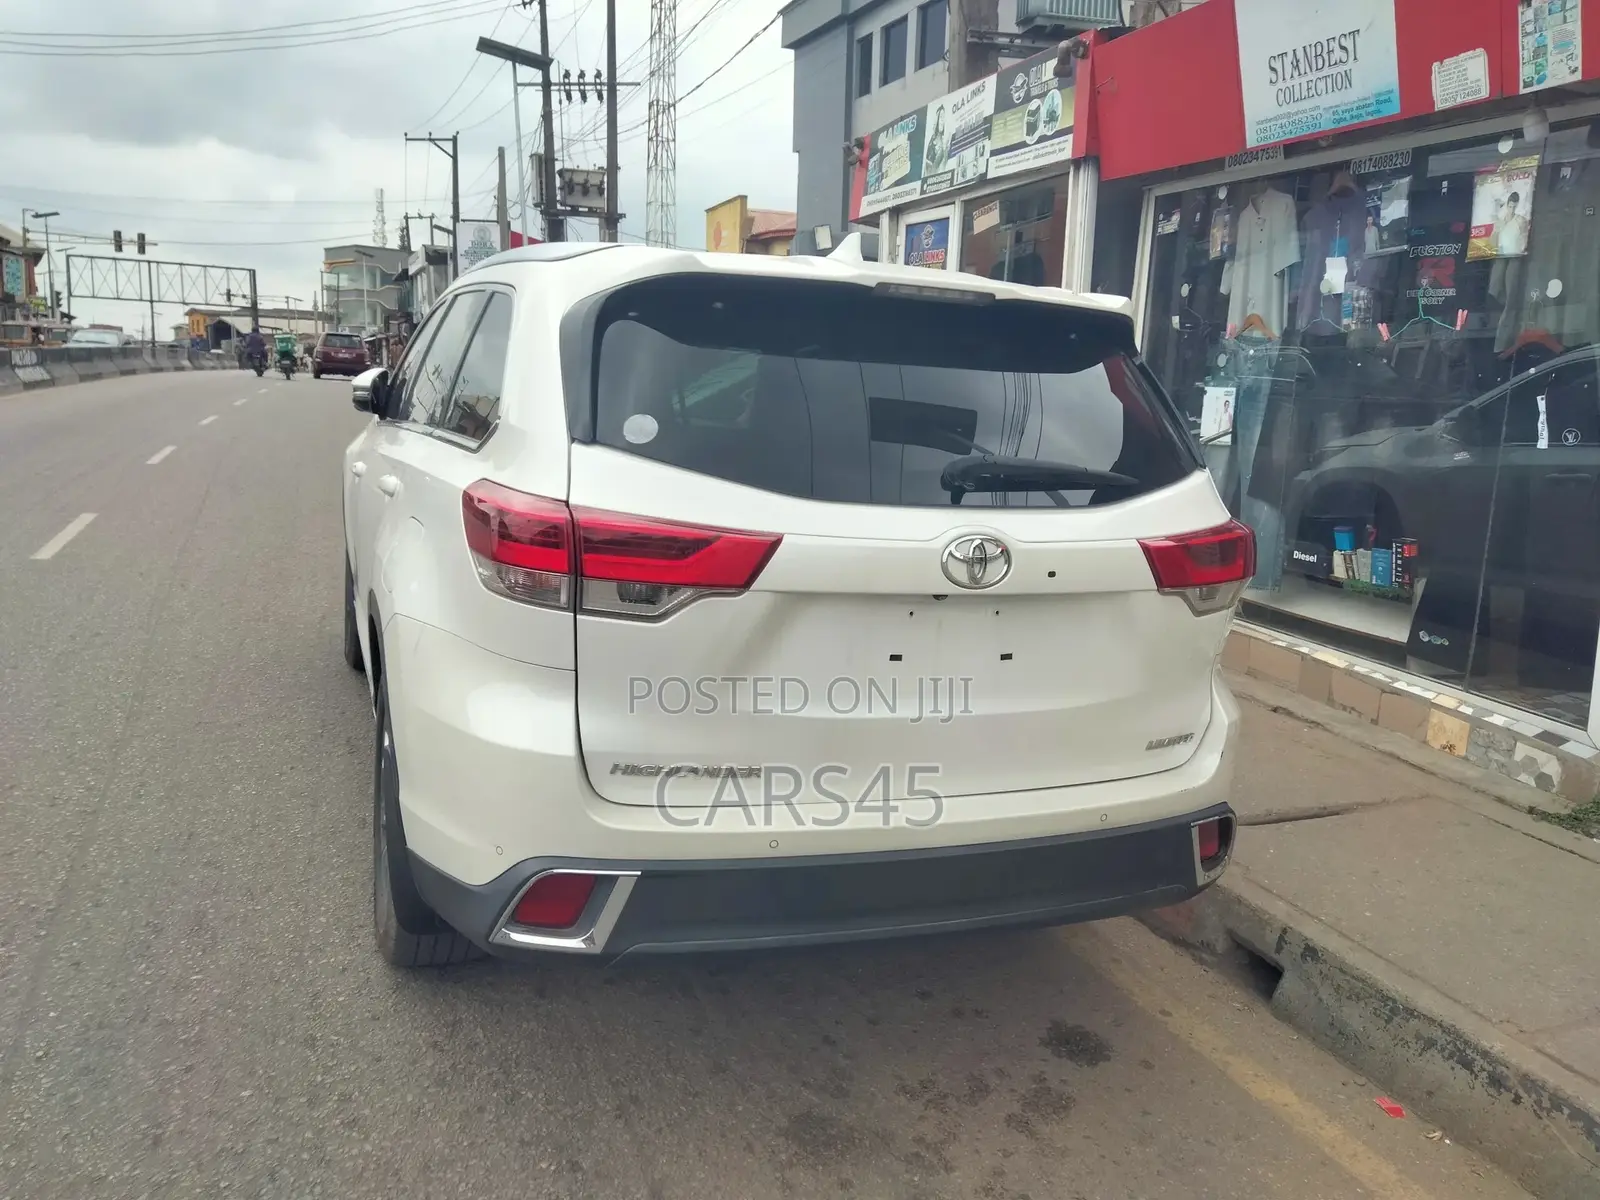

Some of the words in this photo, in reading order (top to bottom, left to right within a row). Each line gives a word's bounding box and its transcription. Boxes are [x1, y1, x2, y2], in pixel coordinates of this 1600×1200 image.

[1268, 29, 1360, 84] STANBEST
[952, 97, 966, 115] OLA
[966, 81, 986, 104] LINKS
[1276, 69, 1352, 107] COLLECTION
[1353, 151, 1410, 173] 08174088230
[909, 251, 923, 266] OLA
[923, 249, 945, 264] LINKS
[1293, 551, 1317, 563] Diesel
[609, 762, 762, 779] HIGHLANDER
